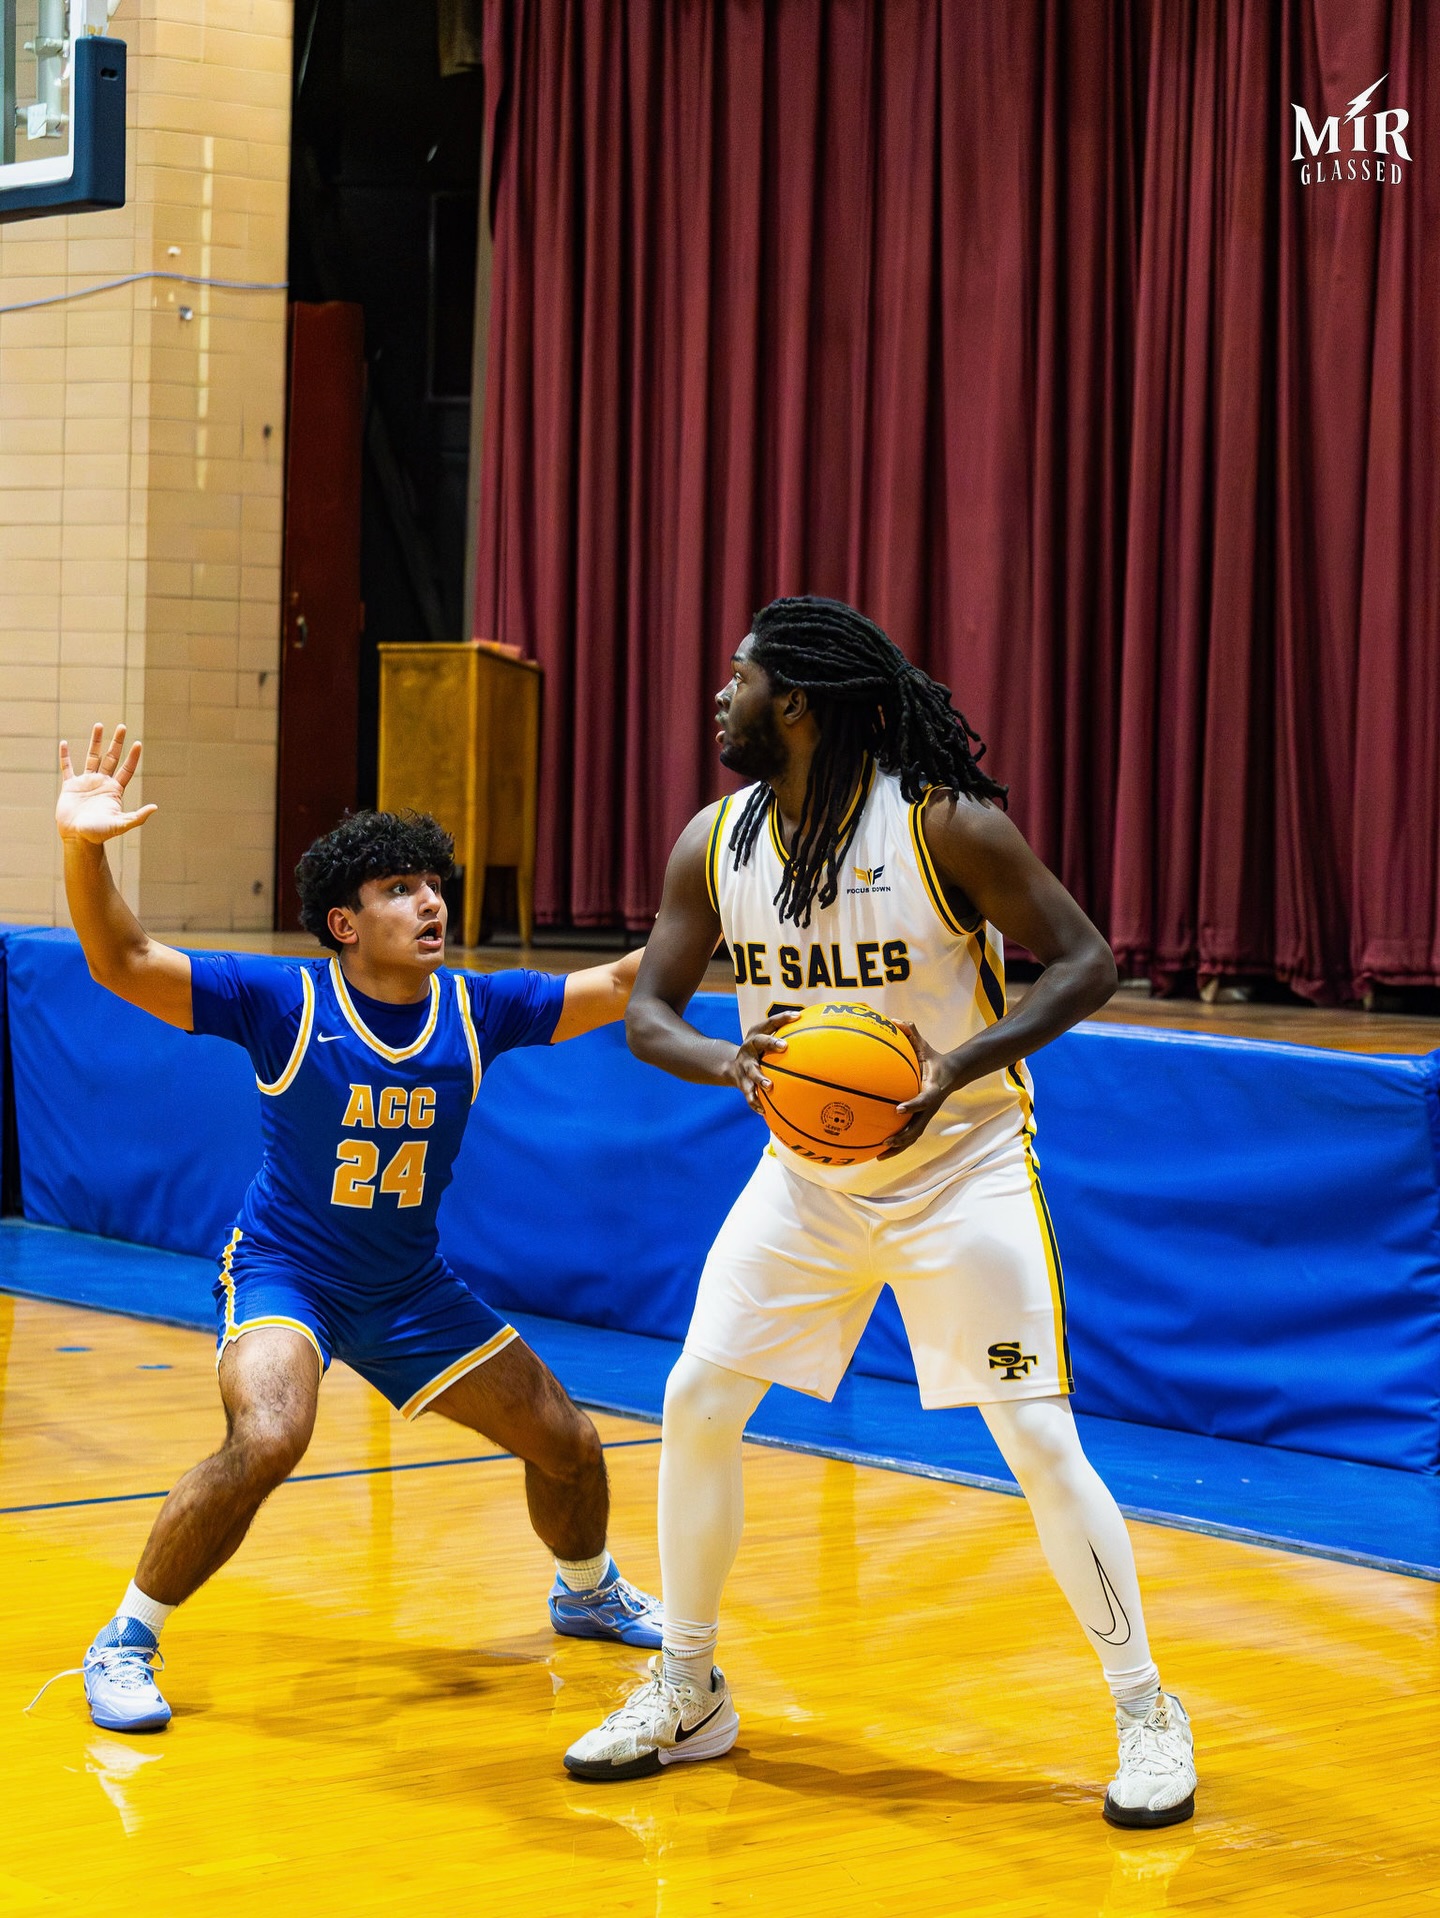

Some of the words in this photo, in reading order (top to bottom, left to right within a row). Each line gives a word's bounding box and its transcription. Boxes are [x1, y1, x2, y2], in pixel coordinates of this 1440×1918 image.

[846, 886, 870, 895] FOCUS
[732, 941, 773, 987] DE
[777, 939, 912, 991] SALES
[822, 1004, 898, 1036] NCAA
[341, 1083, 437, 1129] ACC
[330, 1138, 429, 1209] 24
